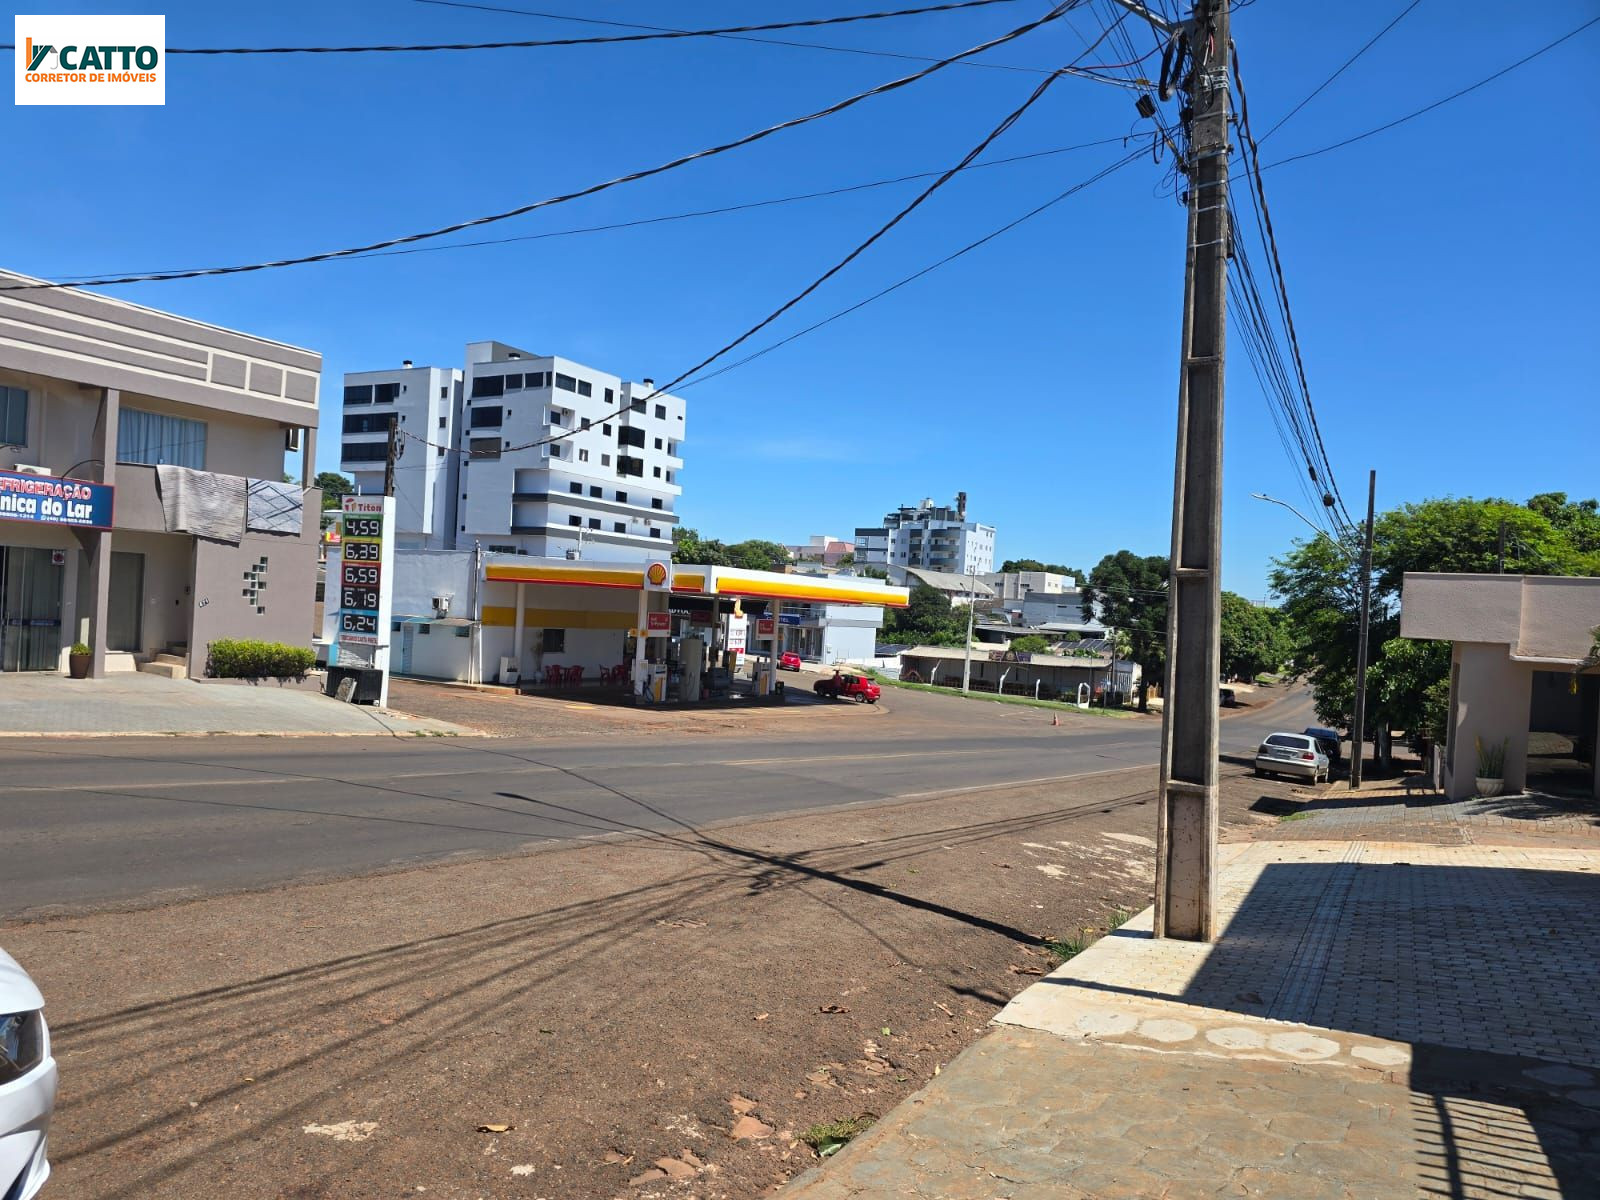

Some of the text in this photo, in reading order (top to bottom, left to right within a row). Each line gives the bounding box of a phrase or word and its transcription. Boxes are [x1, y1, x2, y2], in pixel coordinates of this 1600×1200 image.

[41, 498, 63, 516] do
[67, 501, 93, 519] Lar
[358, 503, 382, 512] Titon
[346, 520, 380, 536] 4,59
[345, 544, 379, 559] 6,39
[345, 567, 378, 584] 6,59
[344, 591, 377, 608] 6,19
[343, 615, 376, 631] 6,24
